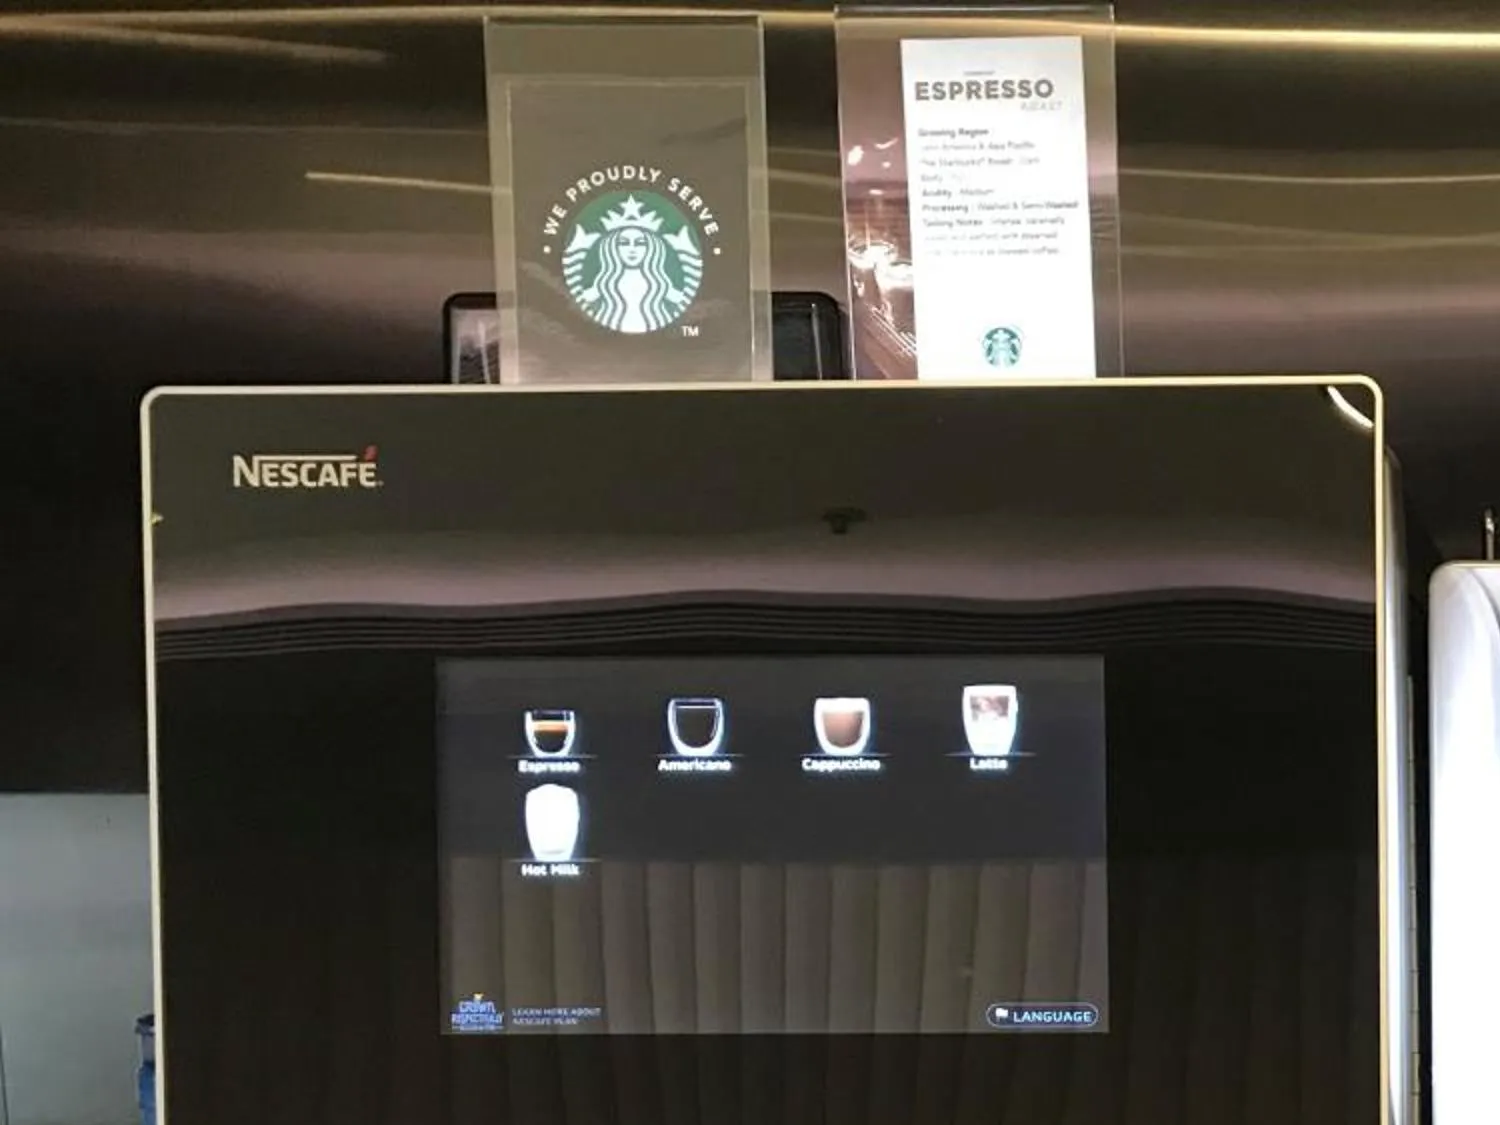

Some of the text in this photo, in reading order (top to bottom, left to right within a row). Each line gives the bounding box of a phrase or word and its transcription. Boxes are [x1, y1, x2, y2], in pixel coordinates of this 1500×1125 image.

[914, 79, 1055, 101] ESPRESSO
[543, 165, 720, 236] WE PROUDLY SERVE
[681, 325, 699, 336] TM
[518, 760, 580, 773] Espresso
[657, 759, 732, 771] Americano
[802, 758, 881, 772] Cappuccino
[969, 757, 1008, 770] Latte
[521, 864, 580, 876] Hot Milk
[1013, 1011, 1093, 1023] LANGUAGE
